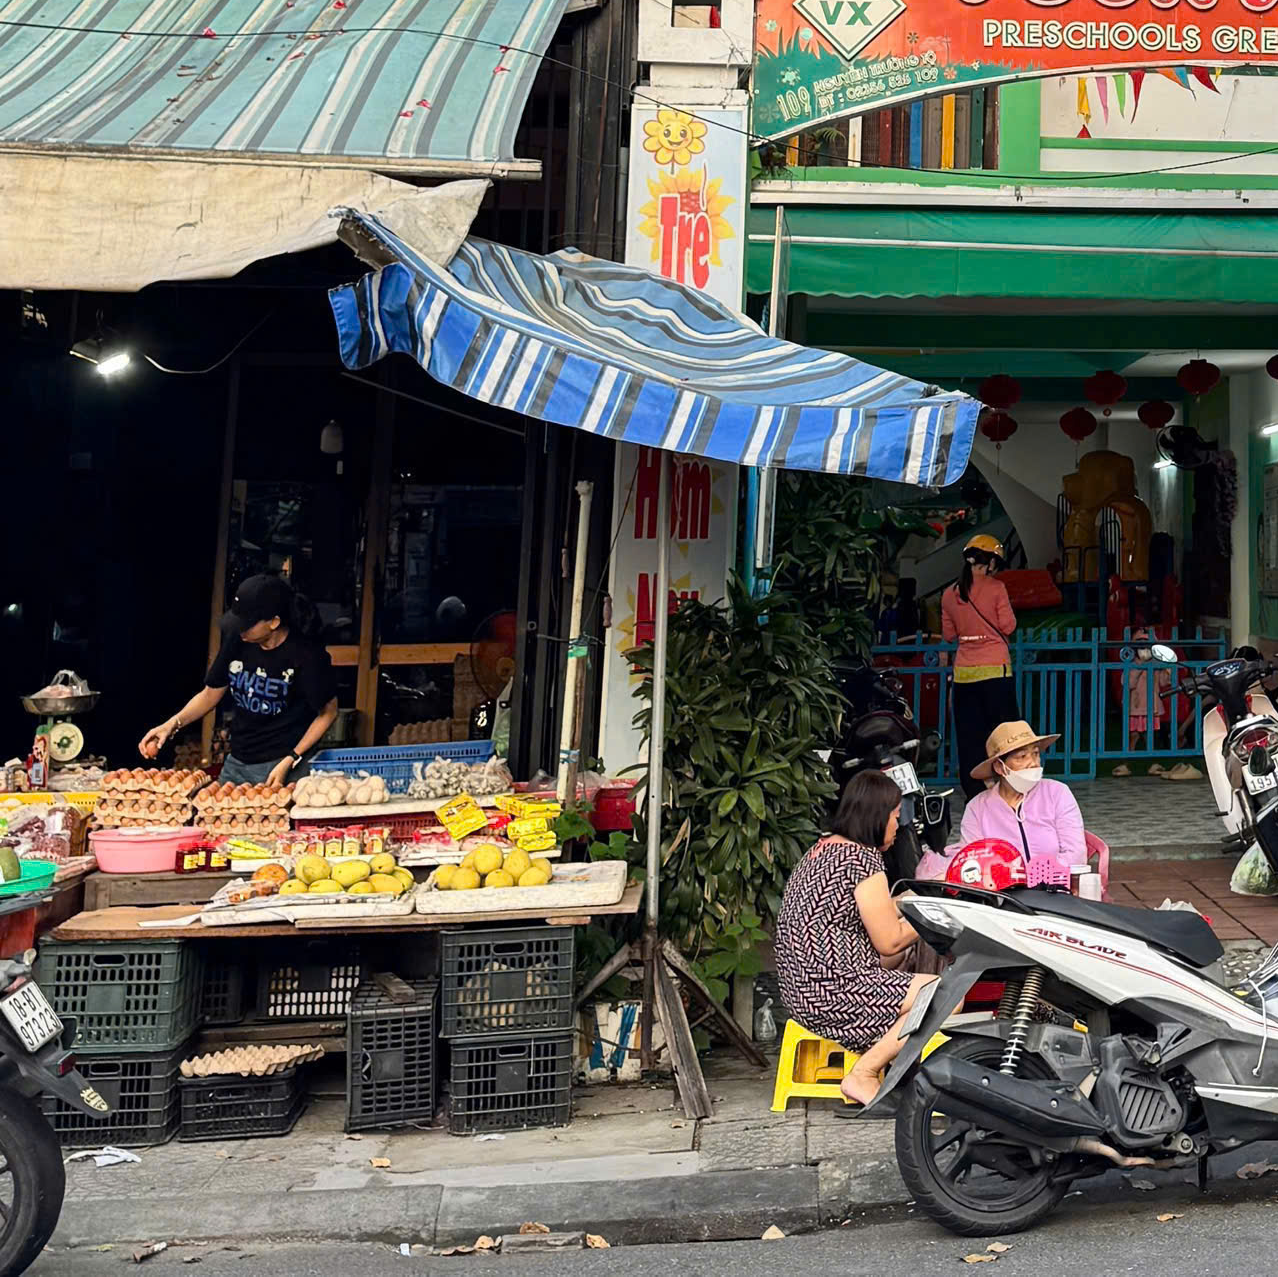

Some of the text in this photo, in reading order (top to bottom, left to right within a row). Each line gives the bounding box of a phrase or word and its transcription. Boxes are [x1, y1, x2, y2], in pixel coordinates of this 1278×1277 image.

[819, 0, 874, 27] VX
[982, 18, 1202, 54] PRESCHOOLS
[776, 86, 813, 122] 109
[1026, 927, 1127, 960] AIR BLADE
